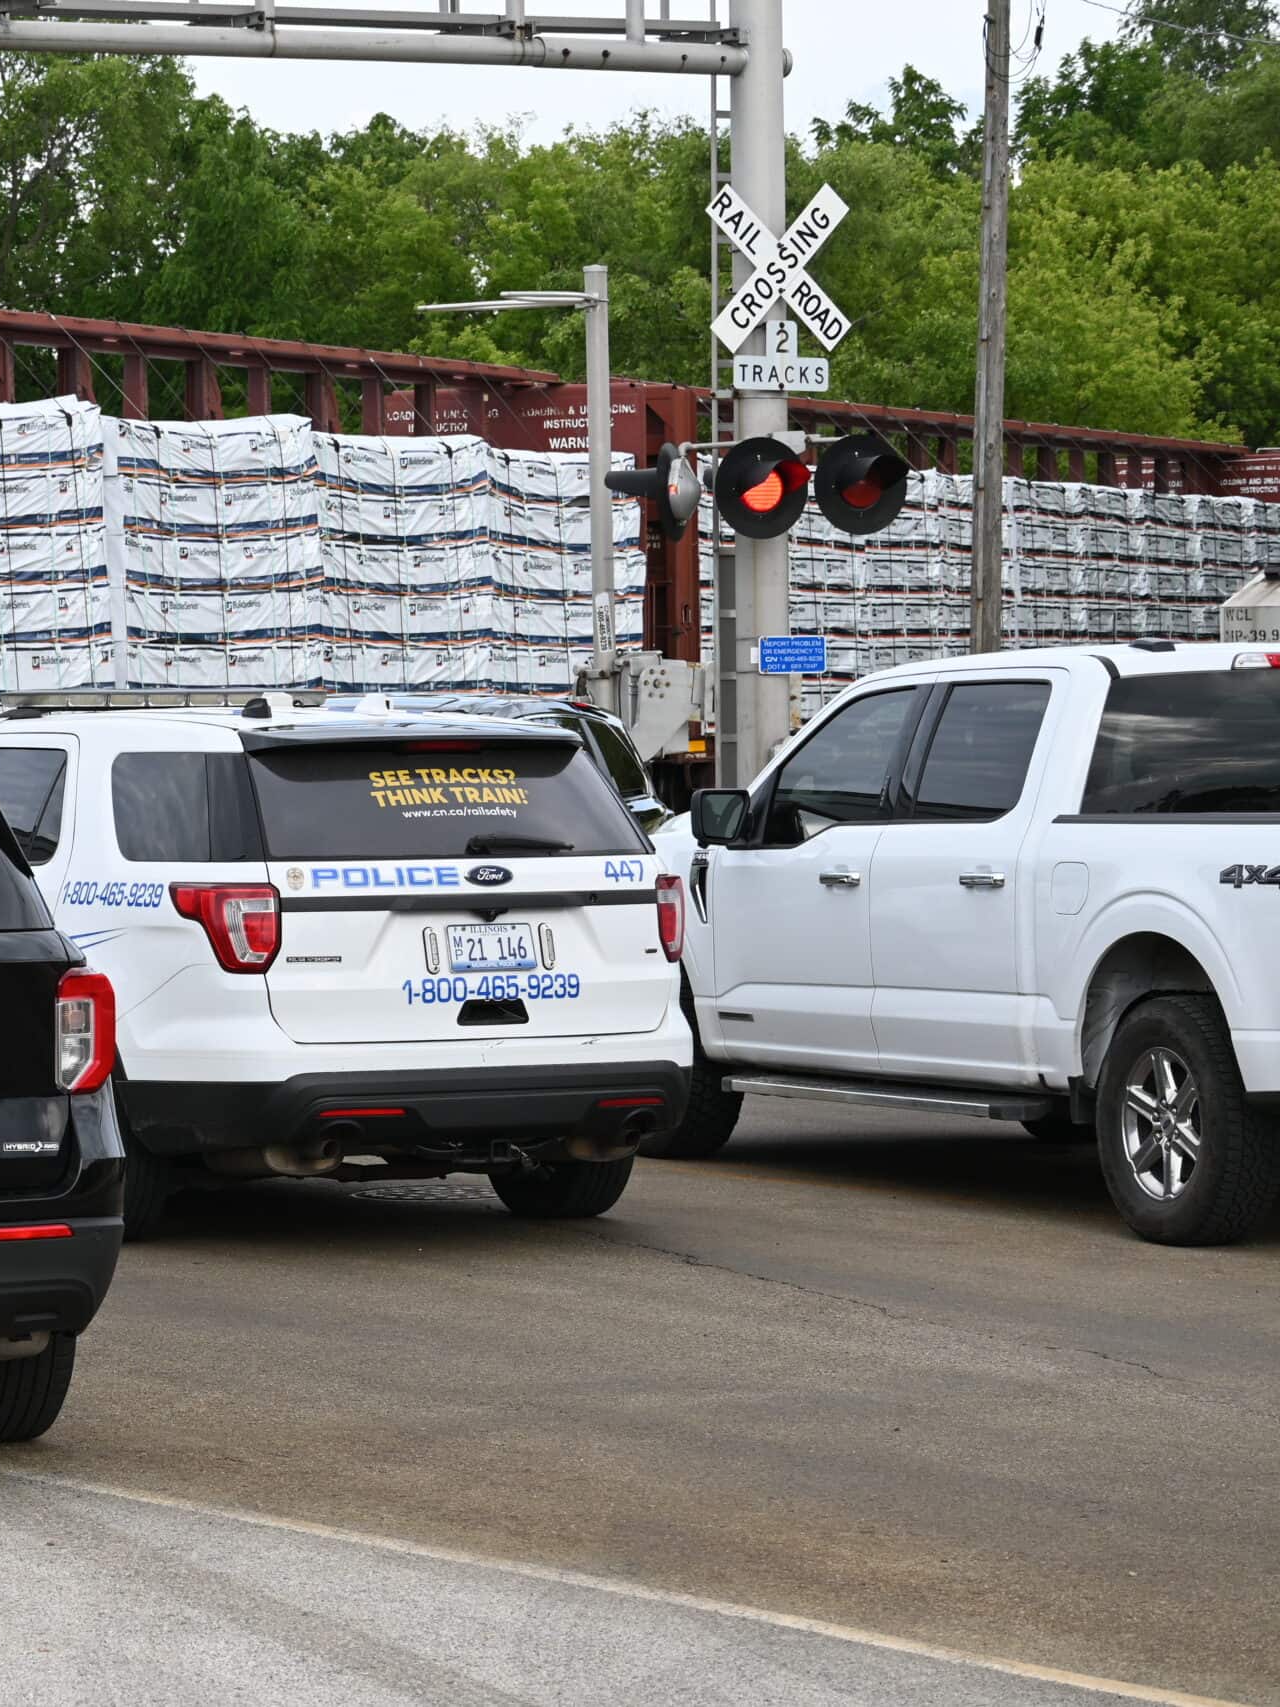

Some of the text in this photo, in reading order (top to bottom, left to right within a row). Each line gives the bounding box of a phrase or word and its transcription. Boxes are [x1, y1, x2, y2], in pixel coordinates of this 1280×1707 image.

[711, 191, 760, 255] RAIL
[730, 207, 830, 330] CROSSING
[791, 281, 842, 341] ROAD
[776, 330, 789, 353] 2
[739, 364, 824, 384] TRACKS
[1225, 608, 1253, 621] WCL
[369, 768, 516, 788] SEE TRACKS?
[370, 787, 529, 807] THINK TRAIN!
[402, 806, 518, 818] www.cn.ca/railsafety
[311, 866, 460, 889] POLICE
[604, 860, 644, 882] 447
[62, 881, 164, 908] 1-800-465-9239
[470, 925, 508, 934] ILLINOIS
[453, 935, 464, 948] M
[466, 936, 527, 961] 21 146
[455, 949, 464, 961] P
[402, 974, 581, 1005] 1-800-465-9239
